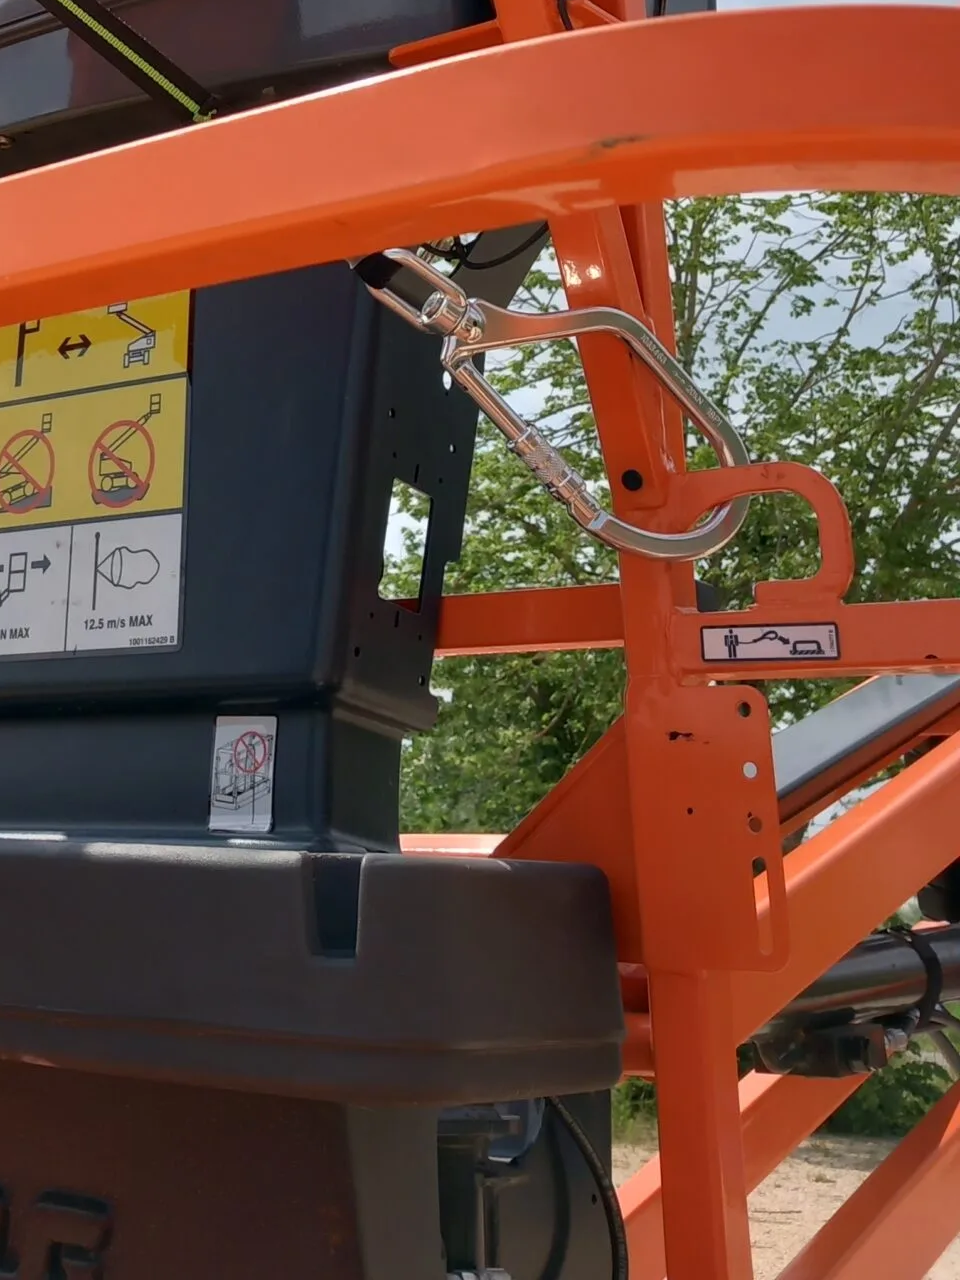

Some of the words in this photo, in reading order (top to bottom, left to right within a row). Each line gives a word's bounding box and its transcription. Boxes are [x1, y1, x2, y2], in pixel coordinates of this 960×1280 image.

[84, 618, 104, 630] 12.5
[107, 617, 126, 629] m/s
[129, 614, 153, 627] MAX
[9, 627, 30, 639] MAX
